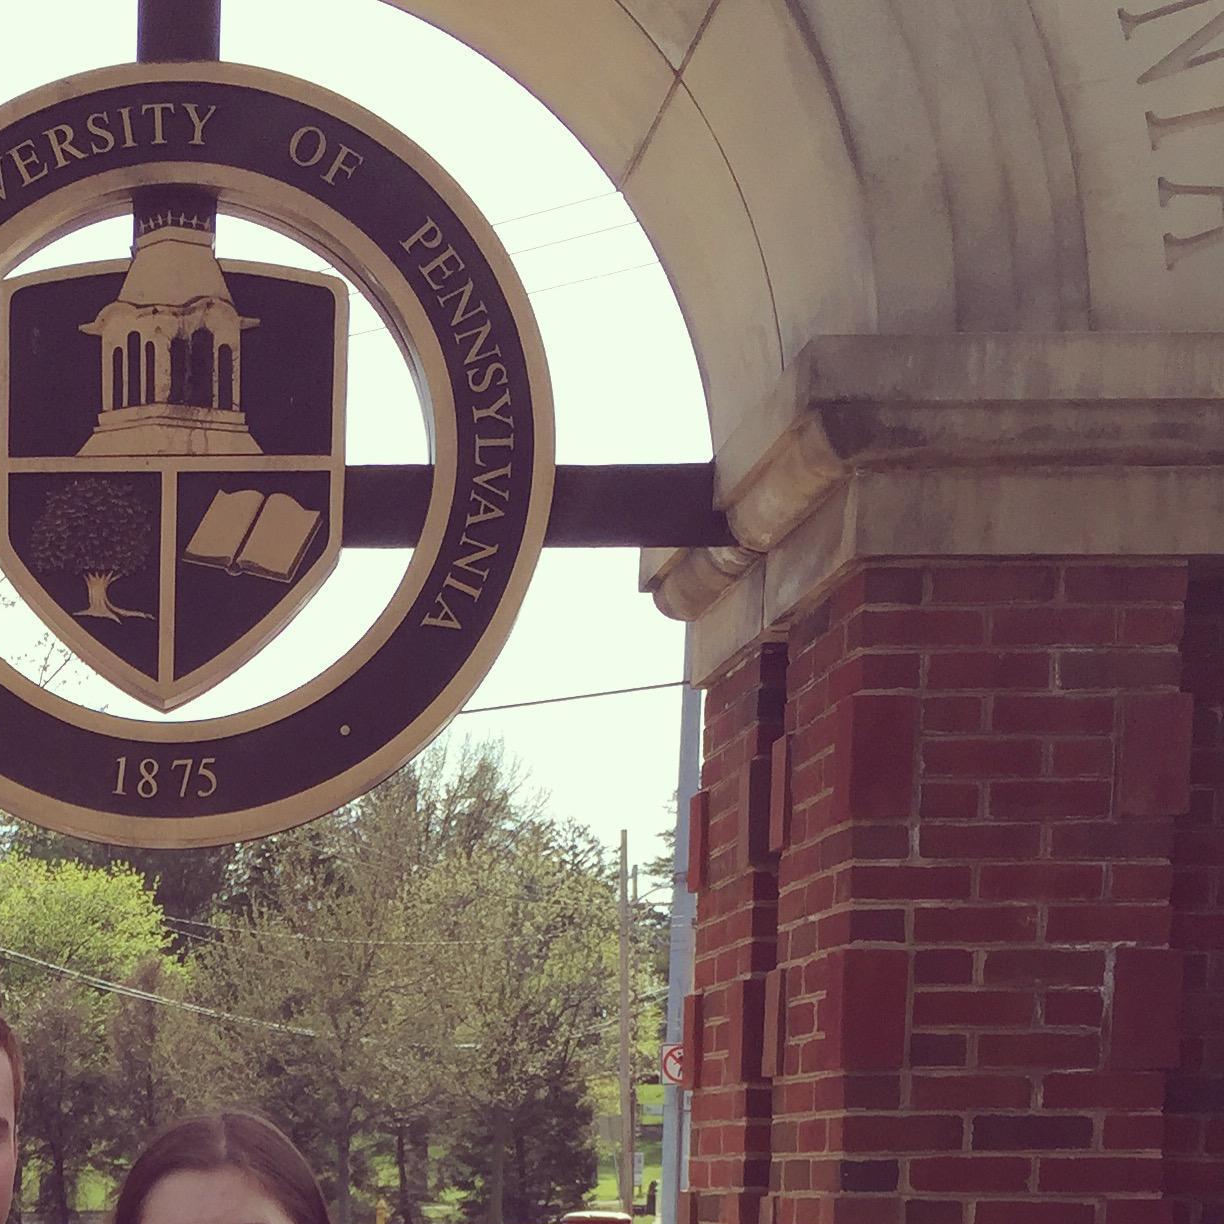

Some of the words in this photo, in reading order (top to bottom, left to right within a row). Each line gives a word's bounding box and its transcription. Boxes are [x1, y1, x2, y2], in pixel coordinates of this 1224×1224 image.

[289, 126, 364, 188] OF
[399, 216, 516, 635] PENNSYLVANIA
[112, 756, 219, 799] 1875
